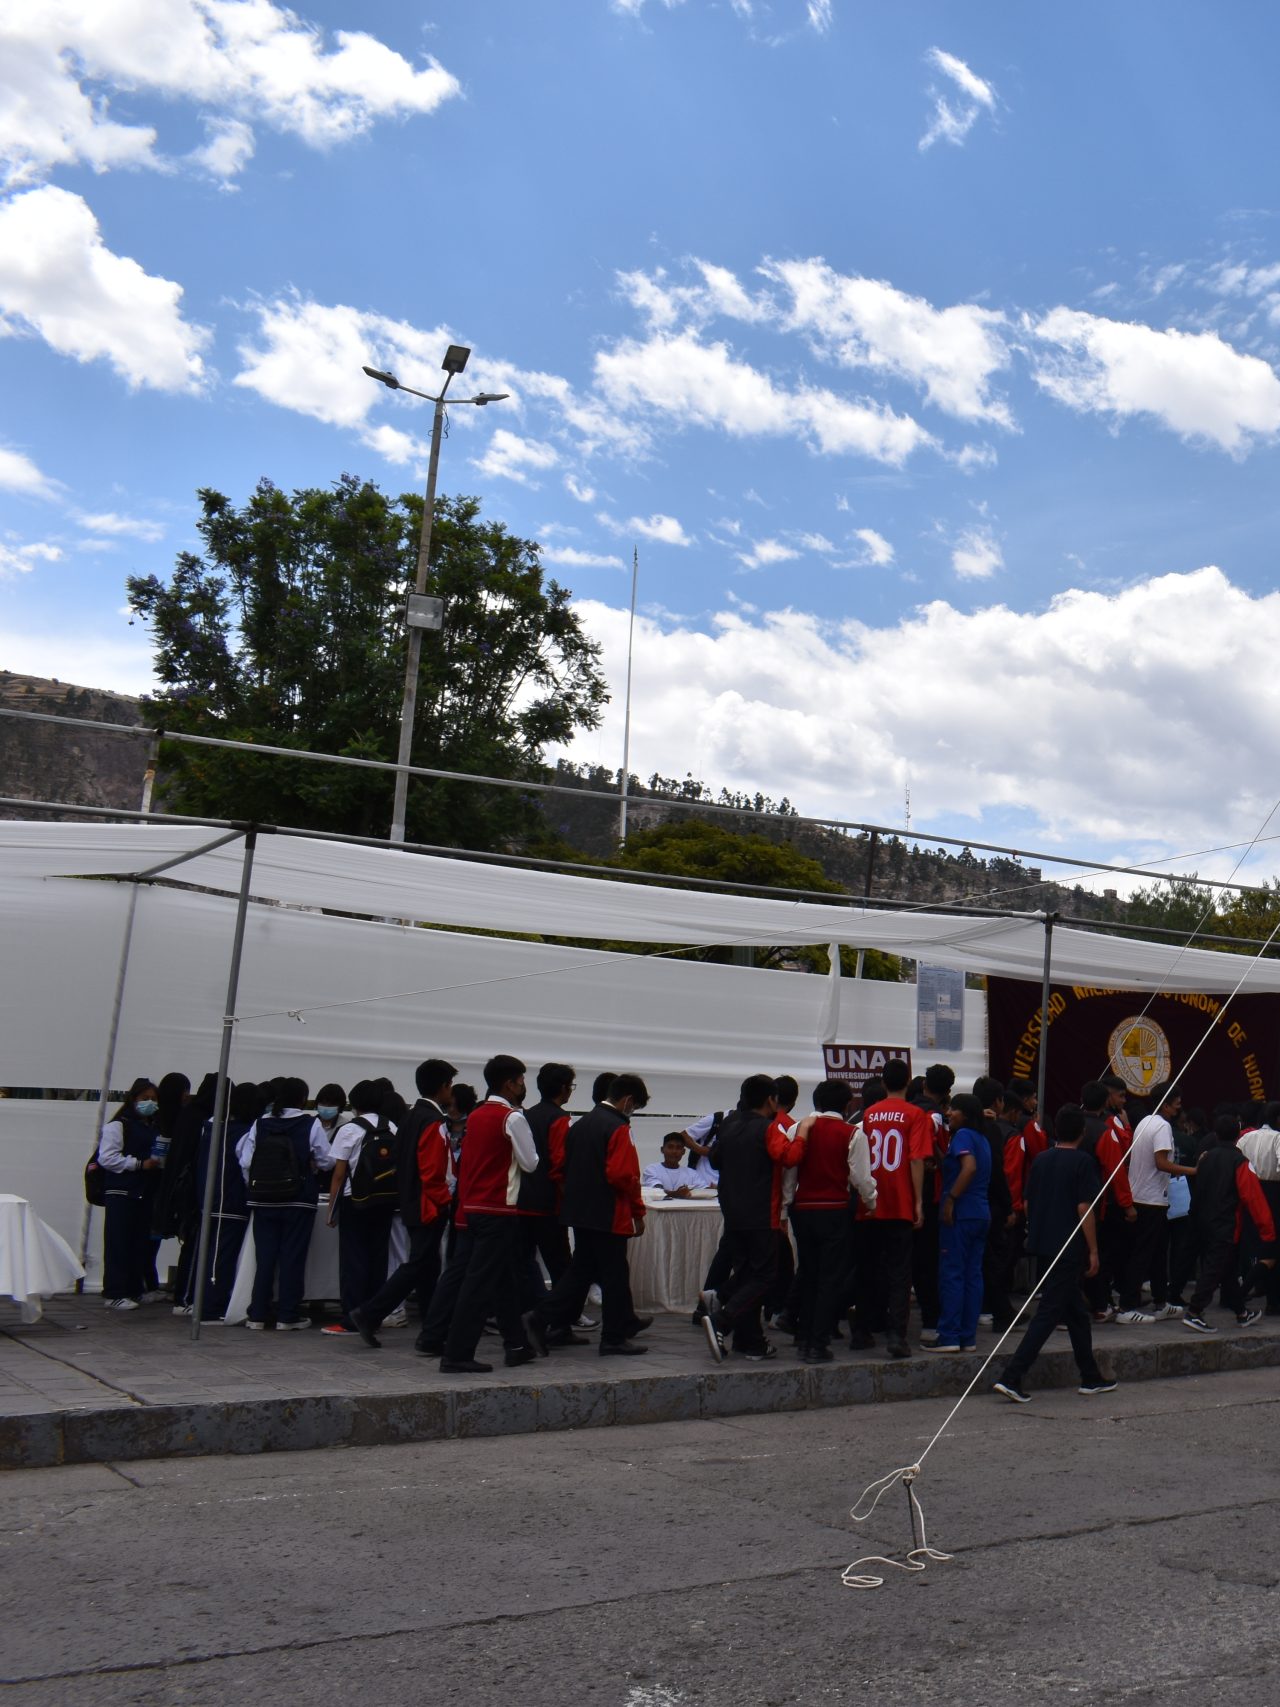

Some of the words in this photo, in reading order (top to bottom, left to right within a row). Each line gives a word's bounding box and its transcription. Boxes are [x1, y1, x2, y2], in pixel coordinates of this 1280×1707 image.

[1226, 1021, 1248, 1048] DE
[1242, 1052, 1267, 1103] HUAN
[868, 1111, 905, 1124] SAMUEL
[869, 1128, 904, 1172] 30
